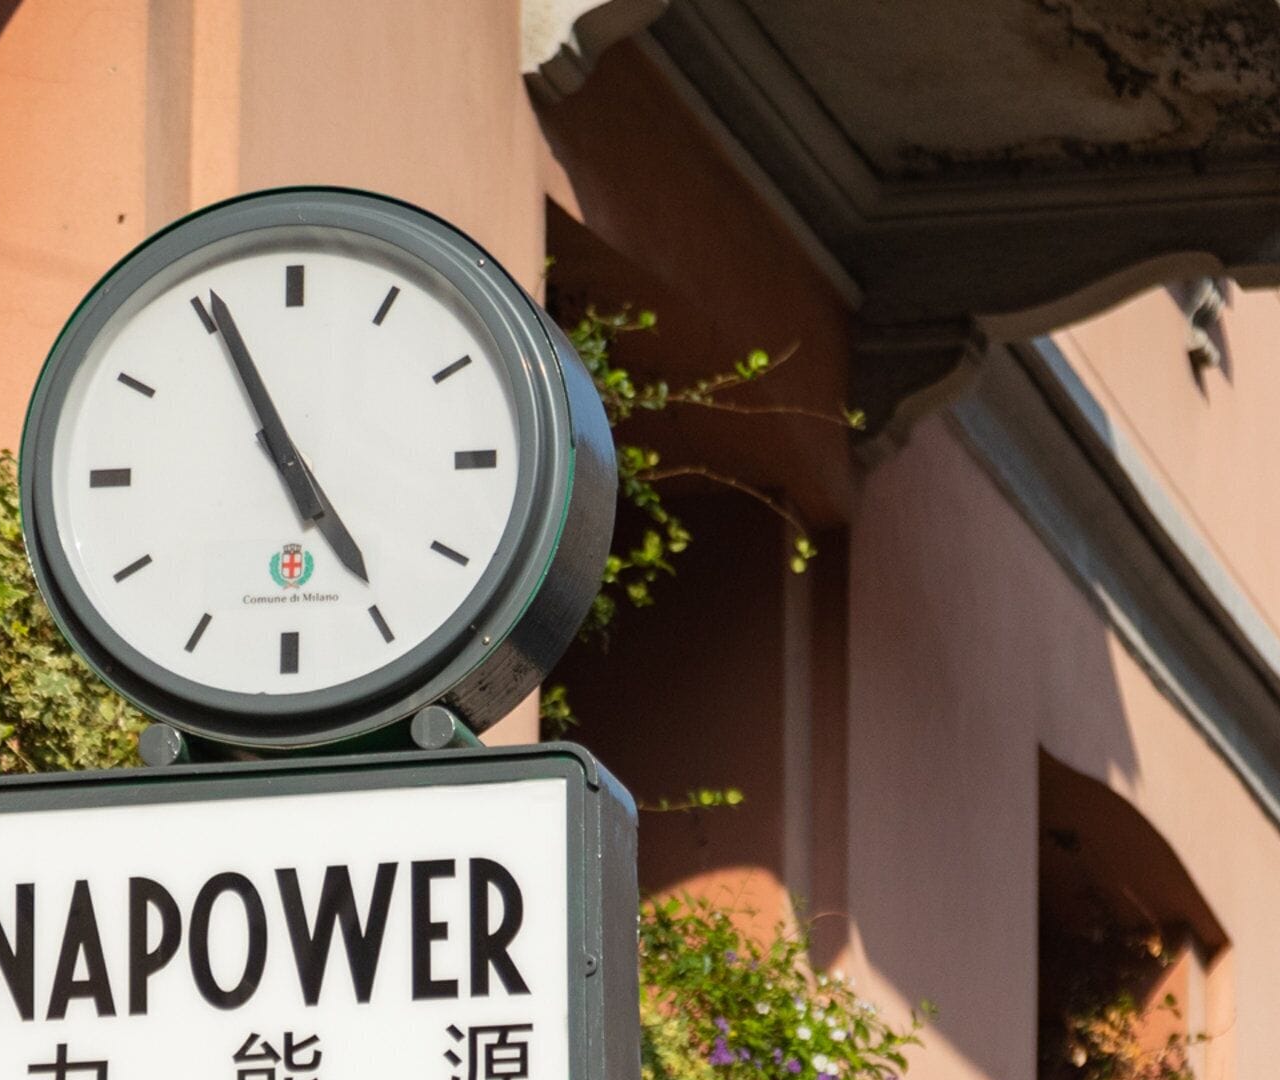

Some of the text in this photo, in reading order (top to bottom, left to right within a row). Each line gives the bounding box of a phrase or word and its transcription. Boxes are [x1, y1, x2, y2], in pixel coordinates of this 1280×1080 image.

[242, 592, 339, 604] Comune di Milano
